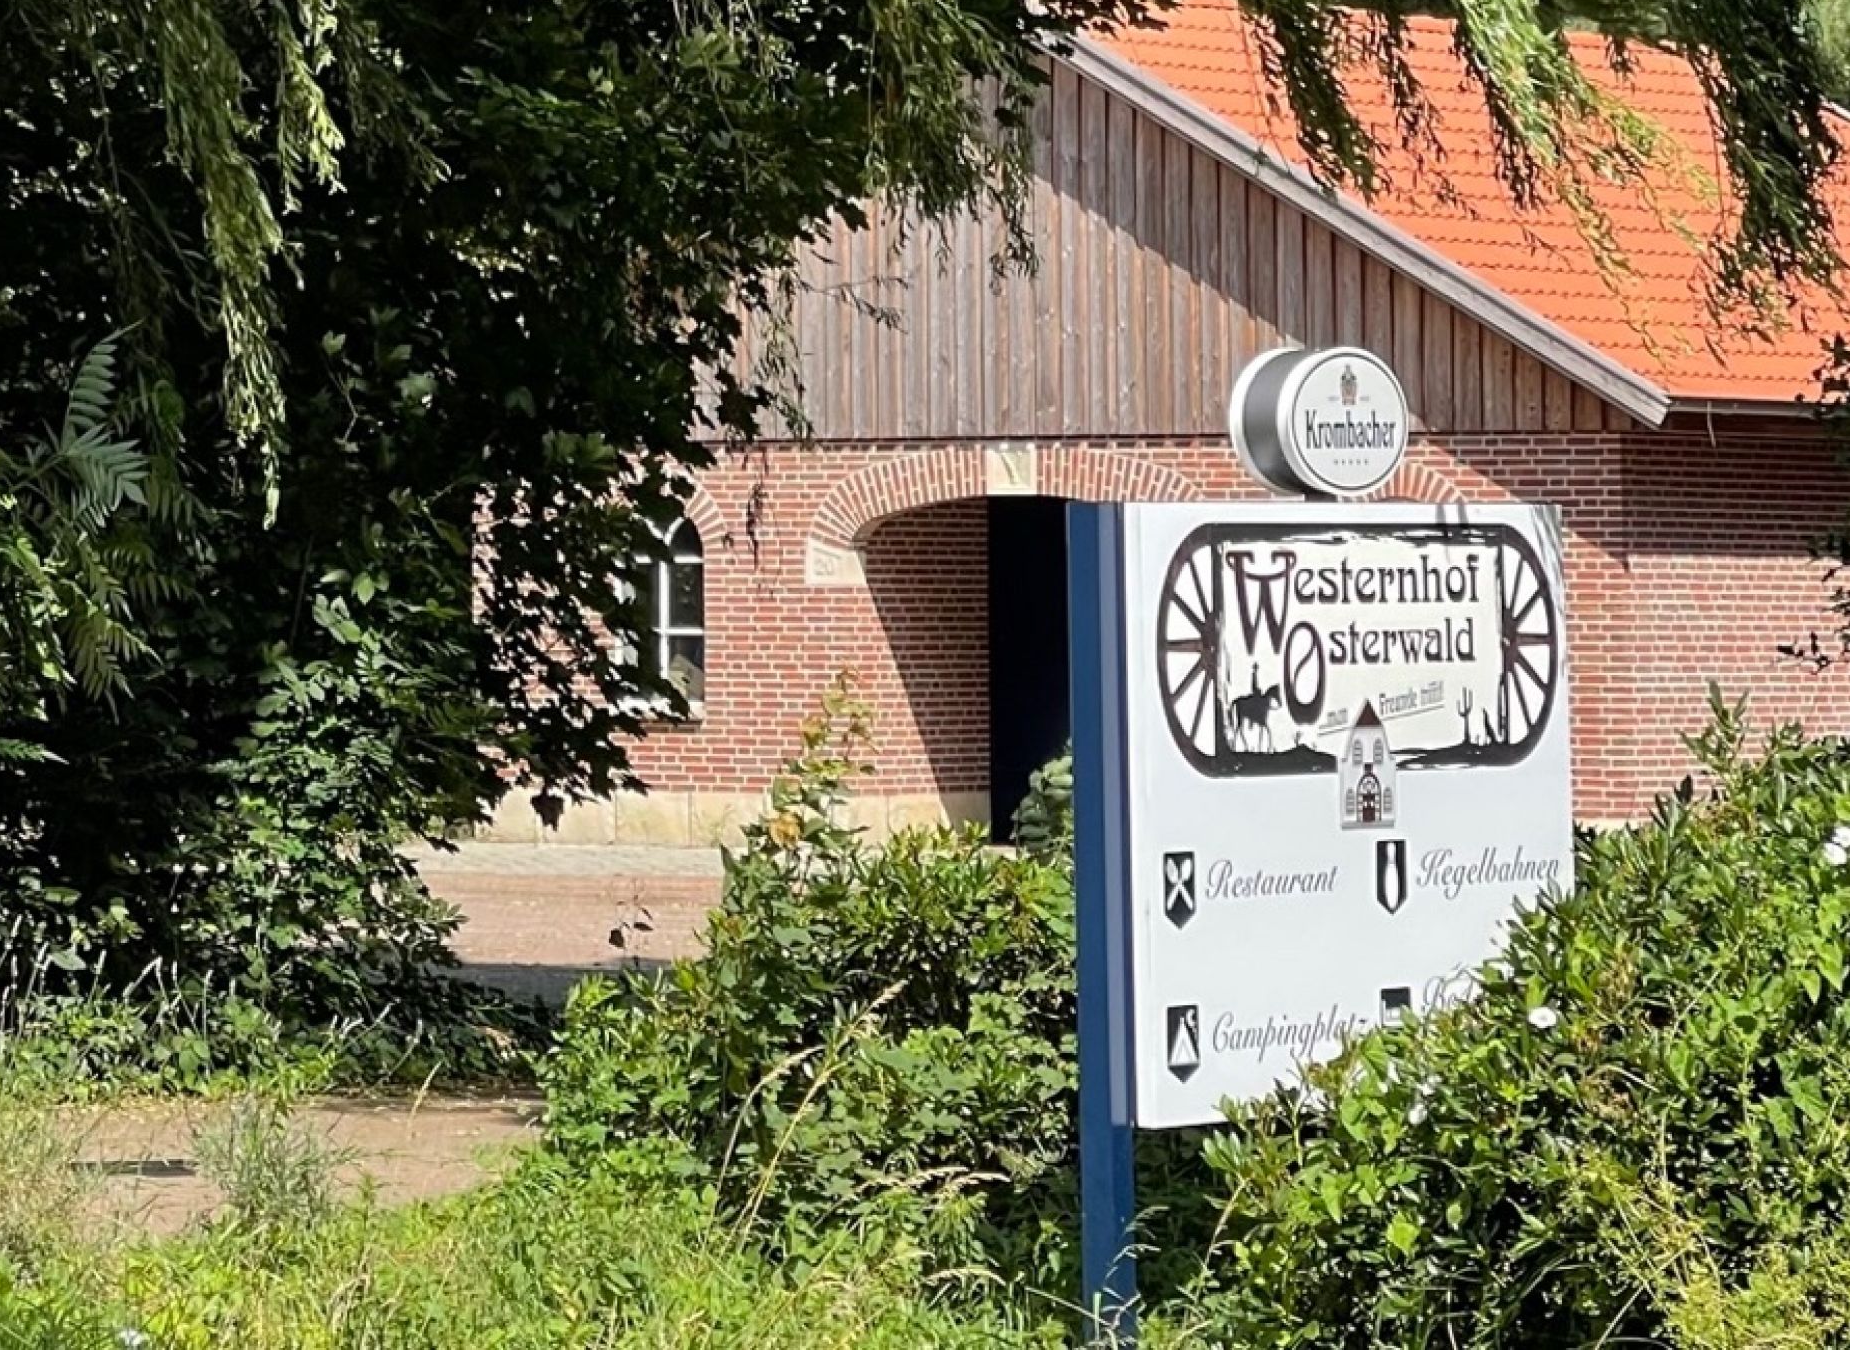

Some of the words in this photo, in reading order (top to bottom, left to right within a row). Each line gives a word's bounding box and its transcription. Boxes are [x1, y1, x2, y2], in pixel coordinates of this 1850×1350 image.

[1305, 409, 1396, 449] Krombacher
[1226, 550, 1478, 655] Westernhof
[1283, 616, 1476, 725] Osterwald
[1205, 859, 1338, 900] Restaurant
[1416, 845, 1559, 900] Kegelbahnen
